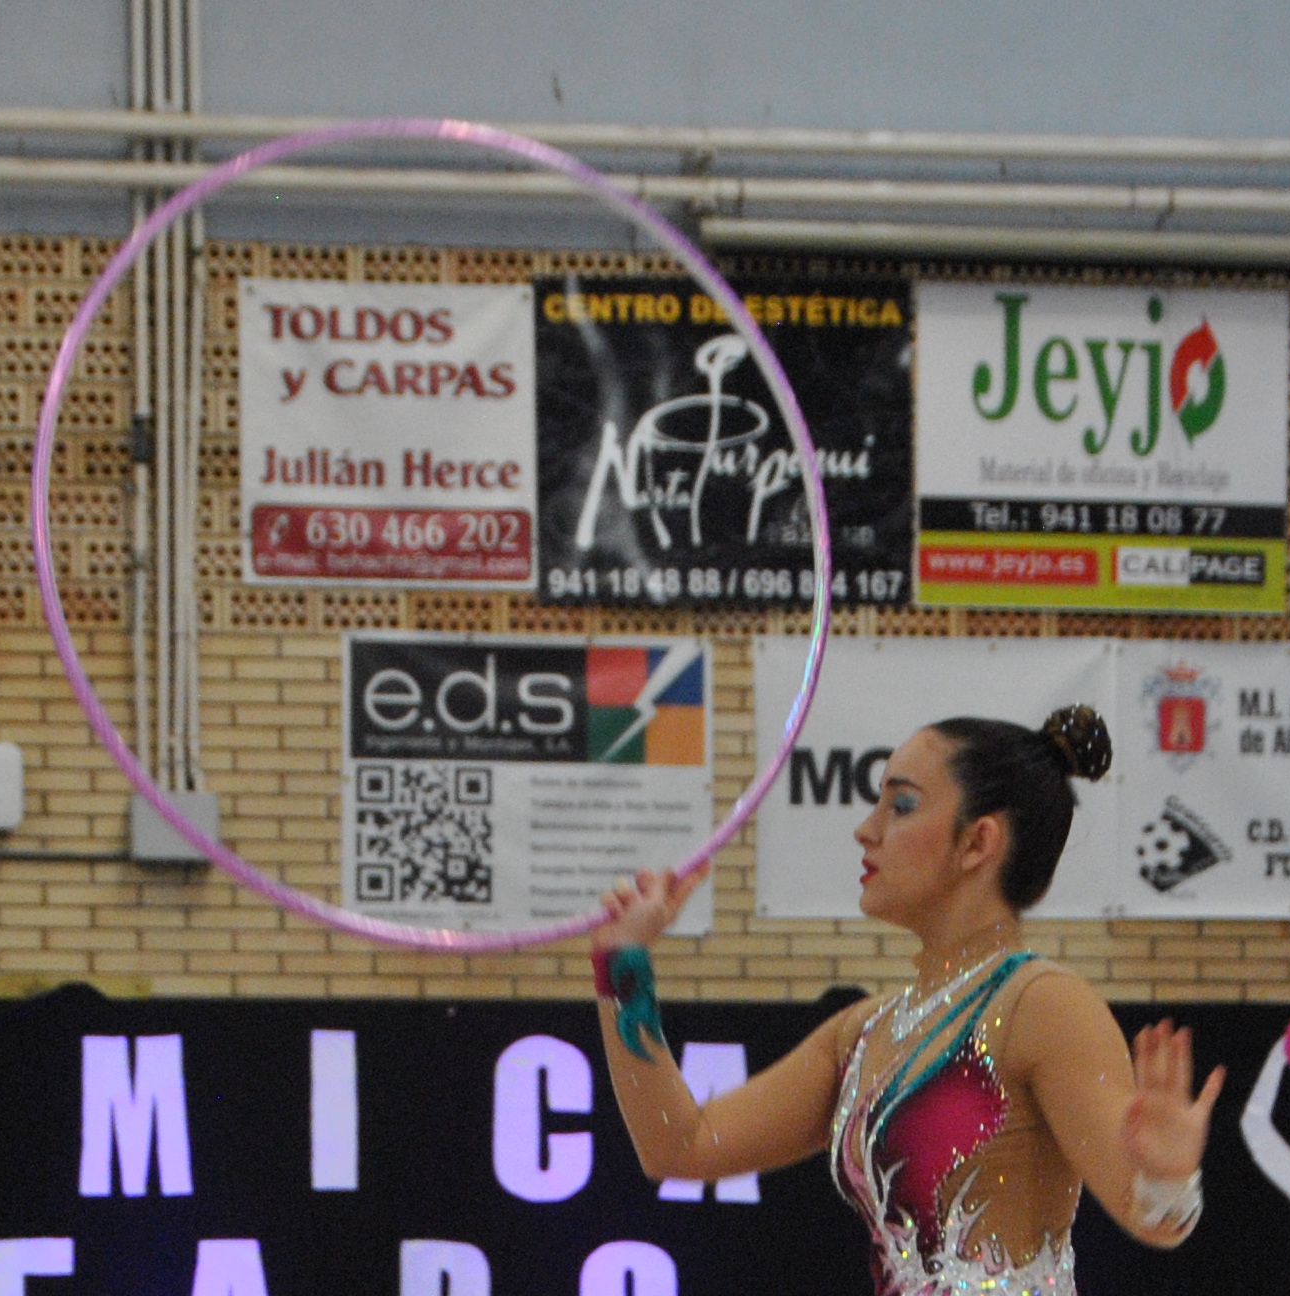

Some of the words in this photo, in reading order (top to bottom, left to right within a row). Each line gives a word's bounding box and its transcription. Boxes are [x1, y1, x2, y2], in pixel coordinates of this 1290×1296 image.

[263, 304, 453, 343] TOLDOS
[543, 293, 683, 324] CENTRO
[281, 366, 306, 402] y
[323, 360, 517, 398] CARPAS
[261, 446, 385, 488] Julián
[402, 449, 521, 489] Herce
[307, 511, 369, 548] 630
[382, 512, 445, 550] 466
[460, 513, 520, 550] 202
[971, 502, 1028, 527] Tel.:
[1040, 504, 1092, 530] 941
[1107, 506, 1139, 532] 18
[1193, 508, 1226, 533] 77
[929, 550, 1086, 575] www.jeyjo.es
[548, 568, 597, 596] 941
[609, 569, 641, 596] 18
[648, 570, 681, 598] 48
[688, 570, 722, 597] 88
[743, 570, 793, 597] 696
[800, 570, 851, 598] 84
[856, 571, 904, 599] 167
[364, 655, 575, 734] e.d.s
[1239, 727, 1264, 754] de
